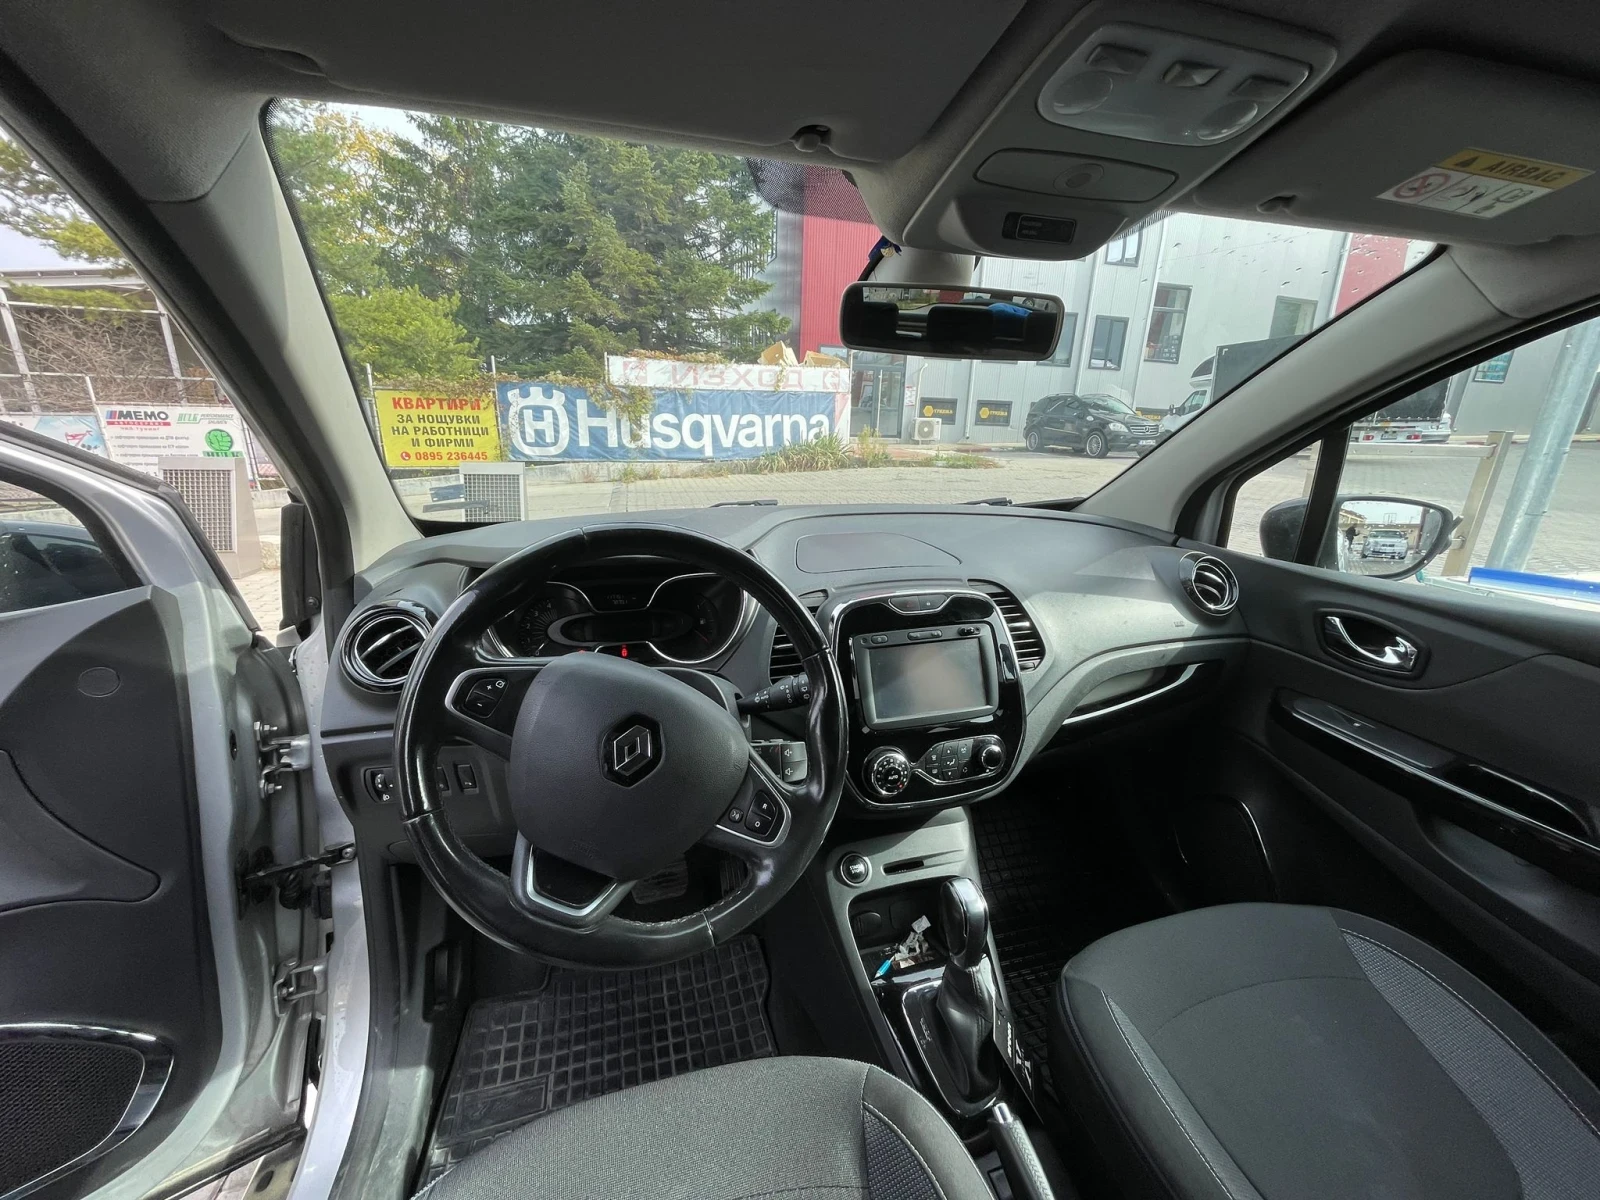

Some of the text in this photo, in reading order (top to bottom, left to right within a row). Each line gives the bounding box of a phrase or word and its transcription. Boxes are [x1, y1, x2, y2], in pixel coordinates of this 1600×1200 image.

[1482, 161, 1567, 183] AIRBAG
[669, 365, 805, 389] ИЗХОД
[392, 397, 482, 411] КВАРТИРИ
[397, 414, 480, 425] ЗА НОЩУВКИ
[392, 426, 489, 437] НА РАБОТНИЦИ
[577, 399, 830, 456] Husqvarna
[411, 438, 474, 448] И ФИРМИ
[415, 452, 488, 461] 0895 236445
